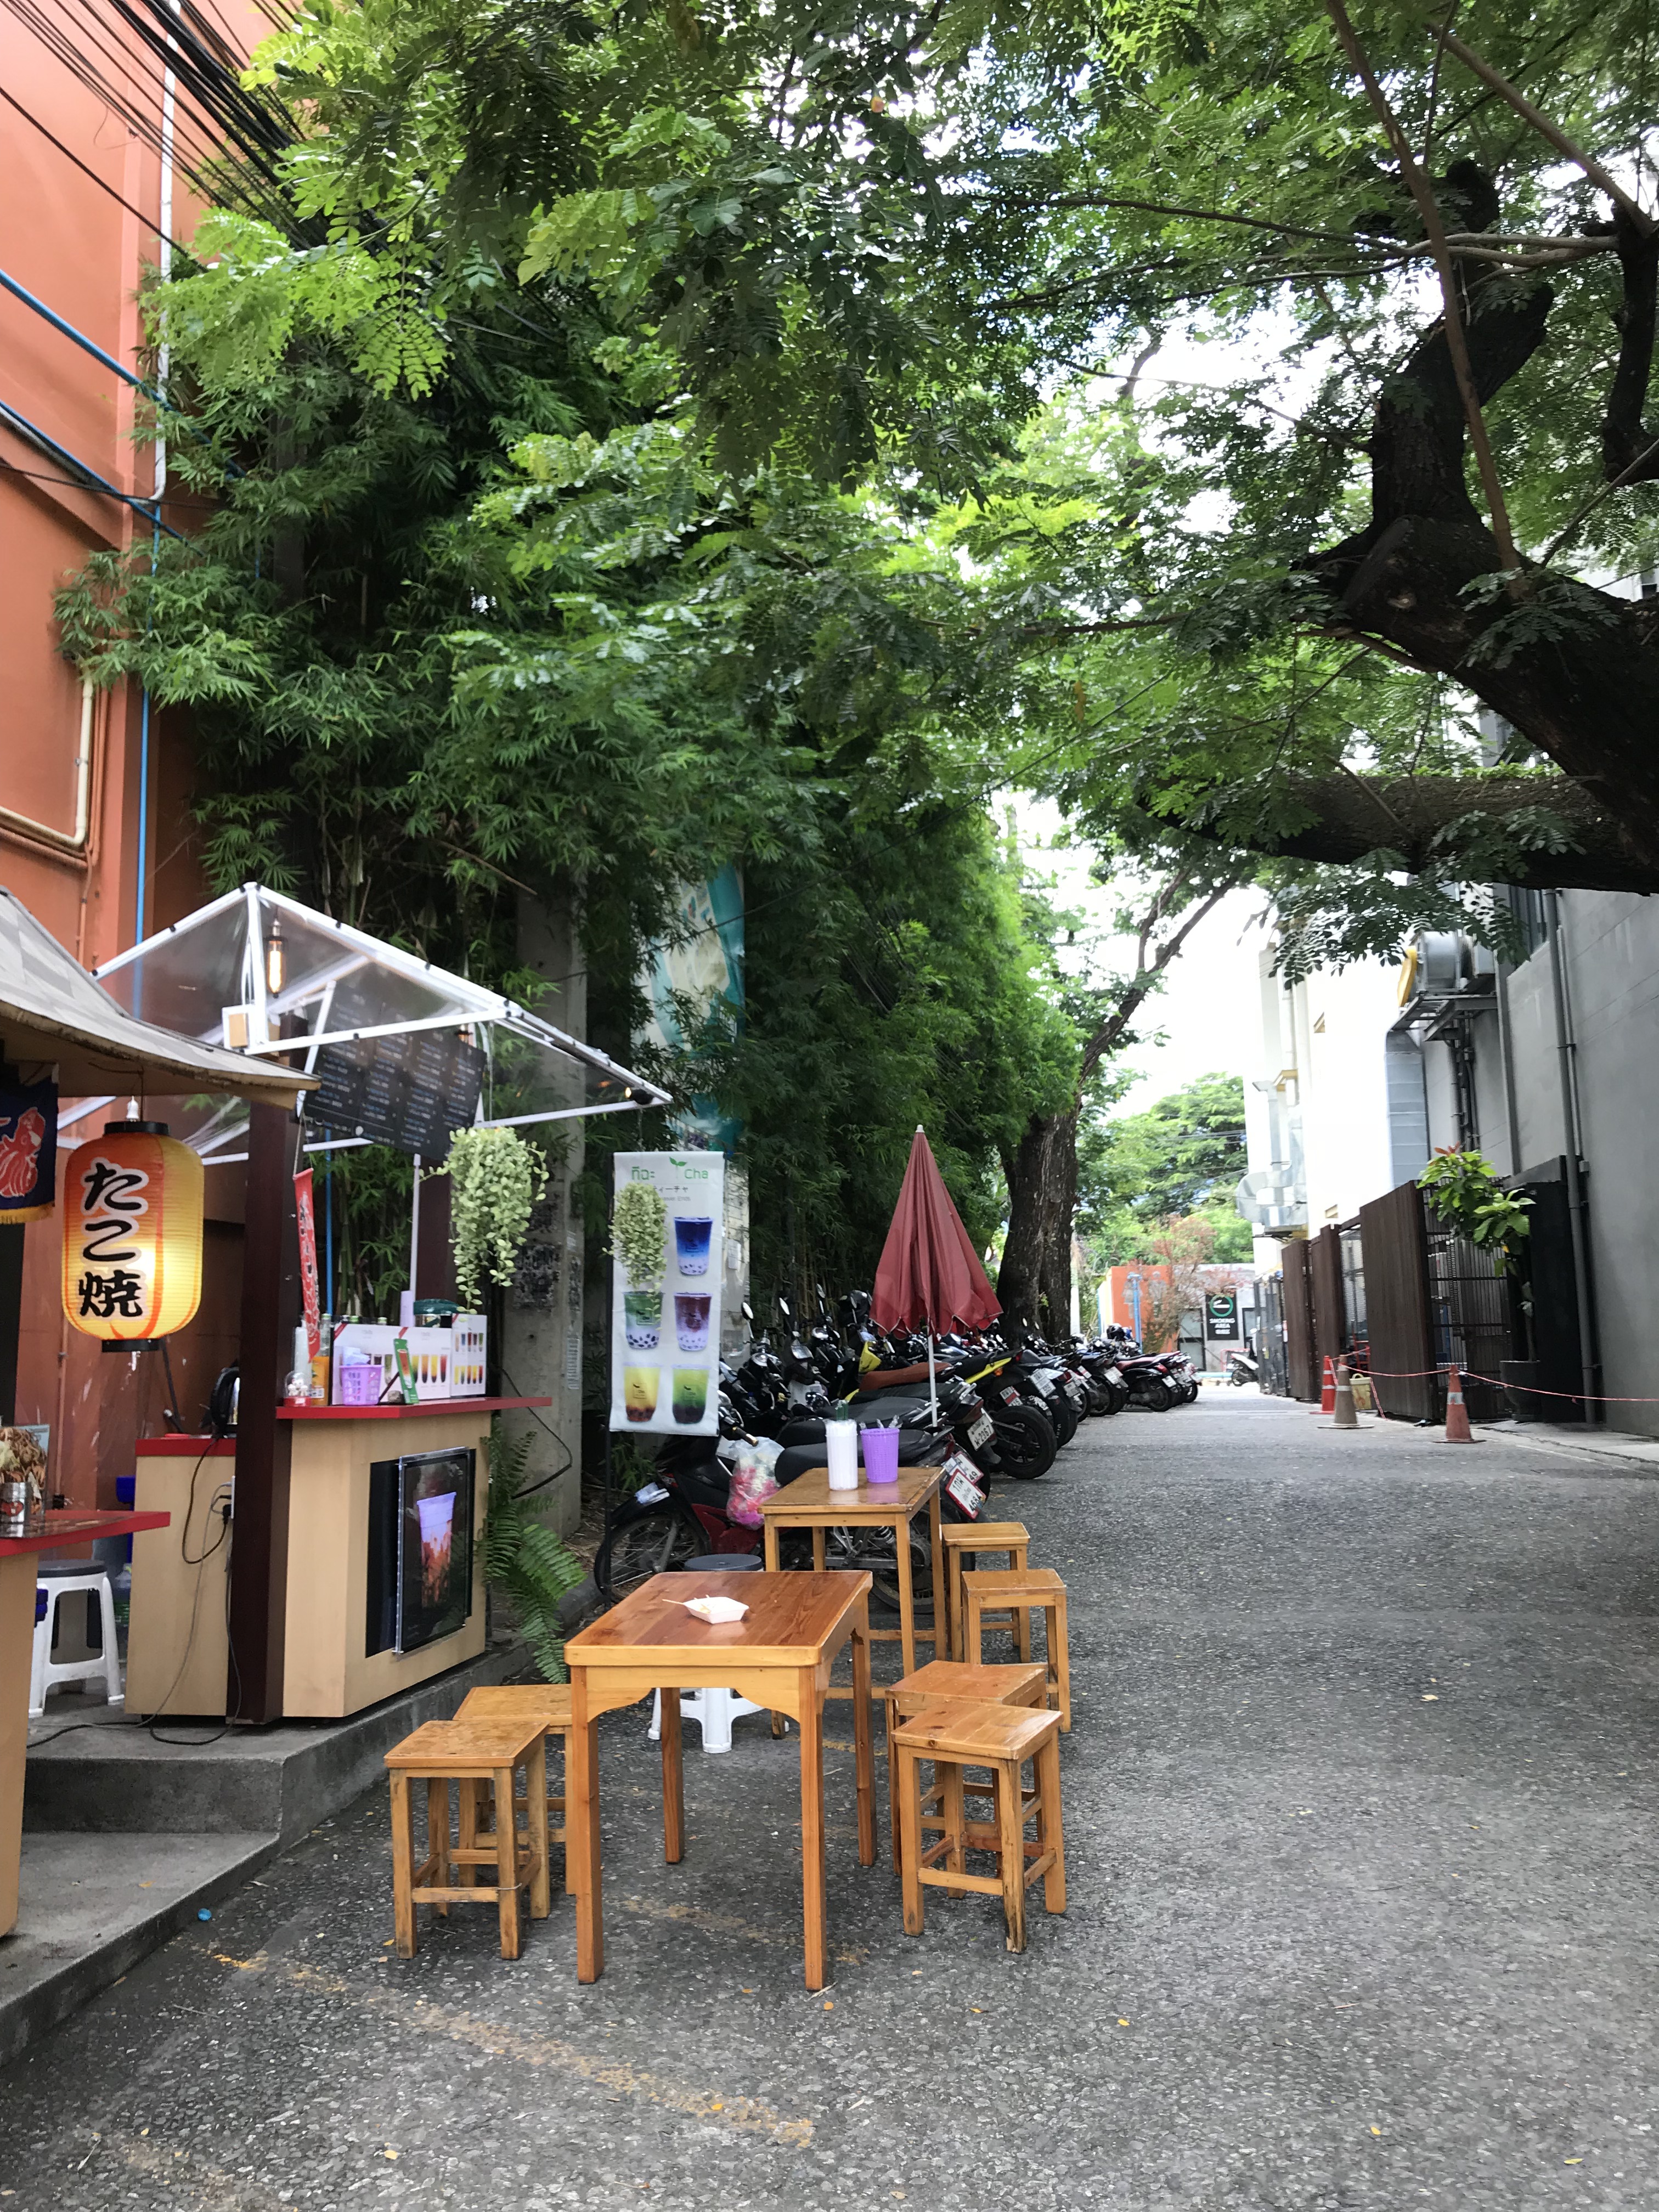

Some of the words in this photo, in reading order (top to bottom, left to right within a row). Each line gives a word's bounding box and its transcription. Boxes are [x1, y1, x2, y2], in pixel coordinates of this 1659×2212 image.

[684, 1168, 709, 1179] Cha
[78, 1161, 143, 1317] たこ焼
